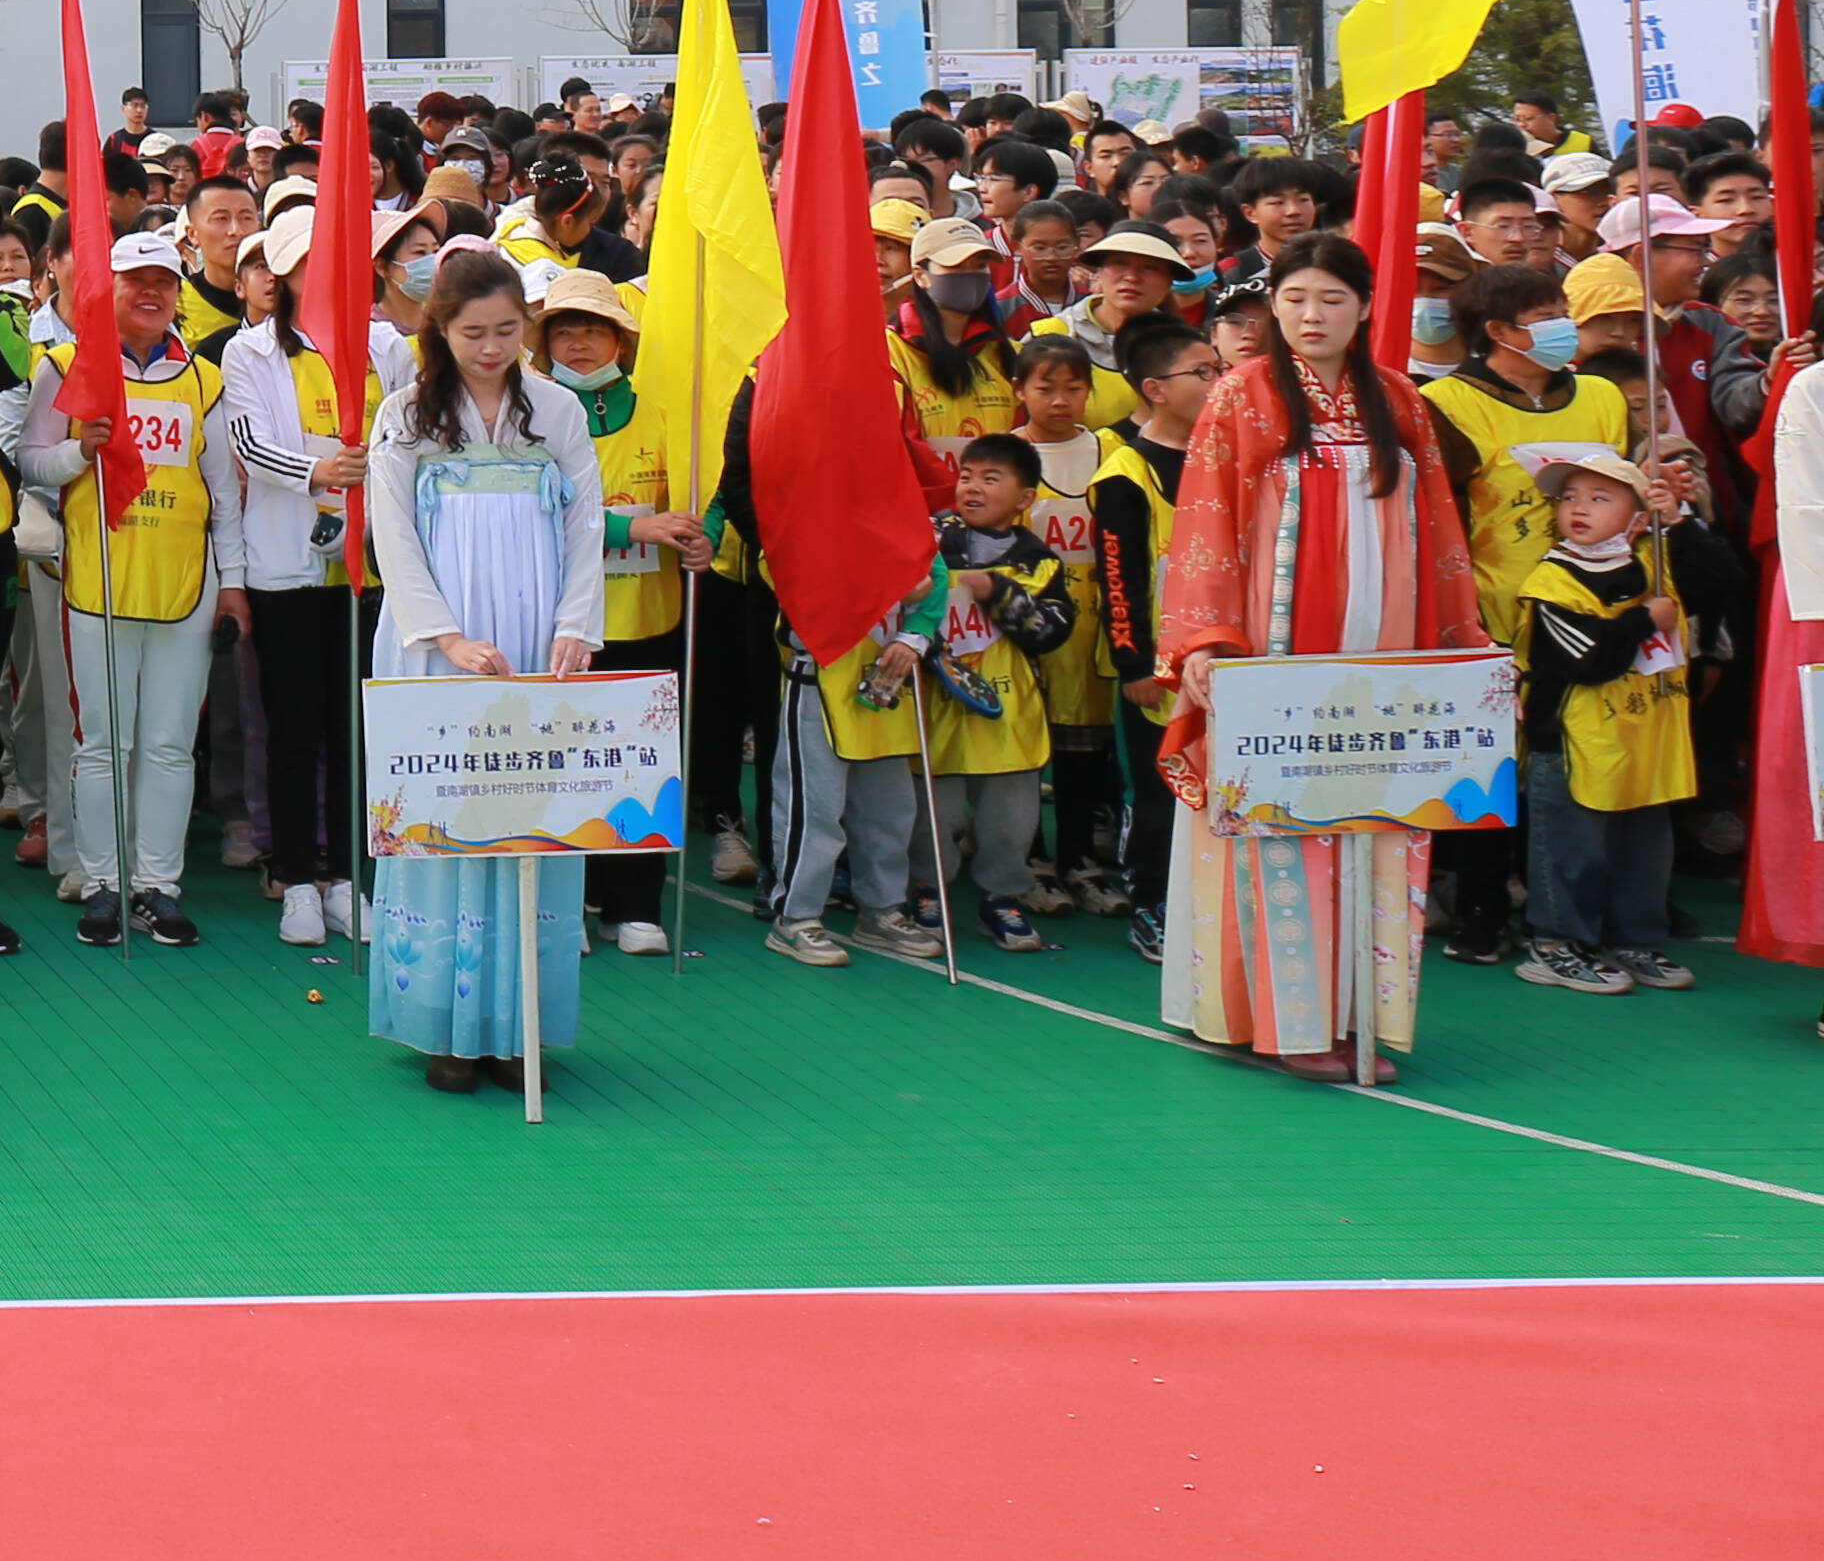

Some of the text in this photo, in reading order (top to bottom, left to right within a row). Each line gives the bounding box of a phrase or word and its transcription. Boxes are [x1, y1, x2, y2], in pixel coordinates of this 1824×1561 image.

[1236, 726, 1495, 756] 2024年徒步齐鲁“东港”站
[389, 745, 658, 776] 2024年徒步齐鲁“东港”站
